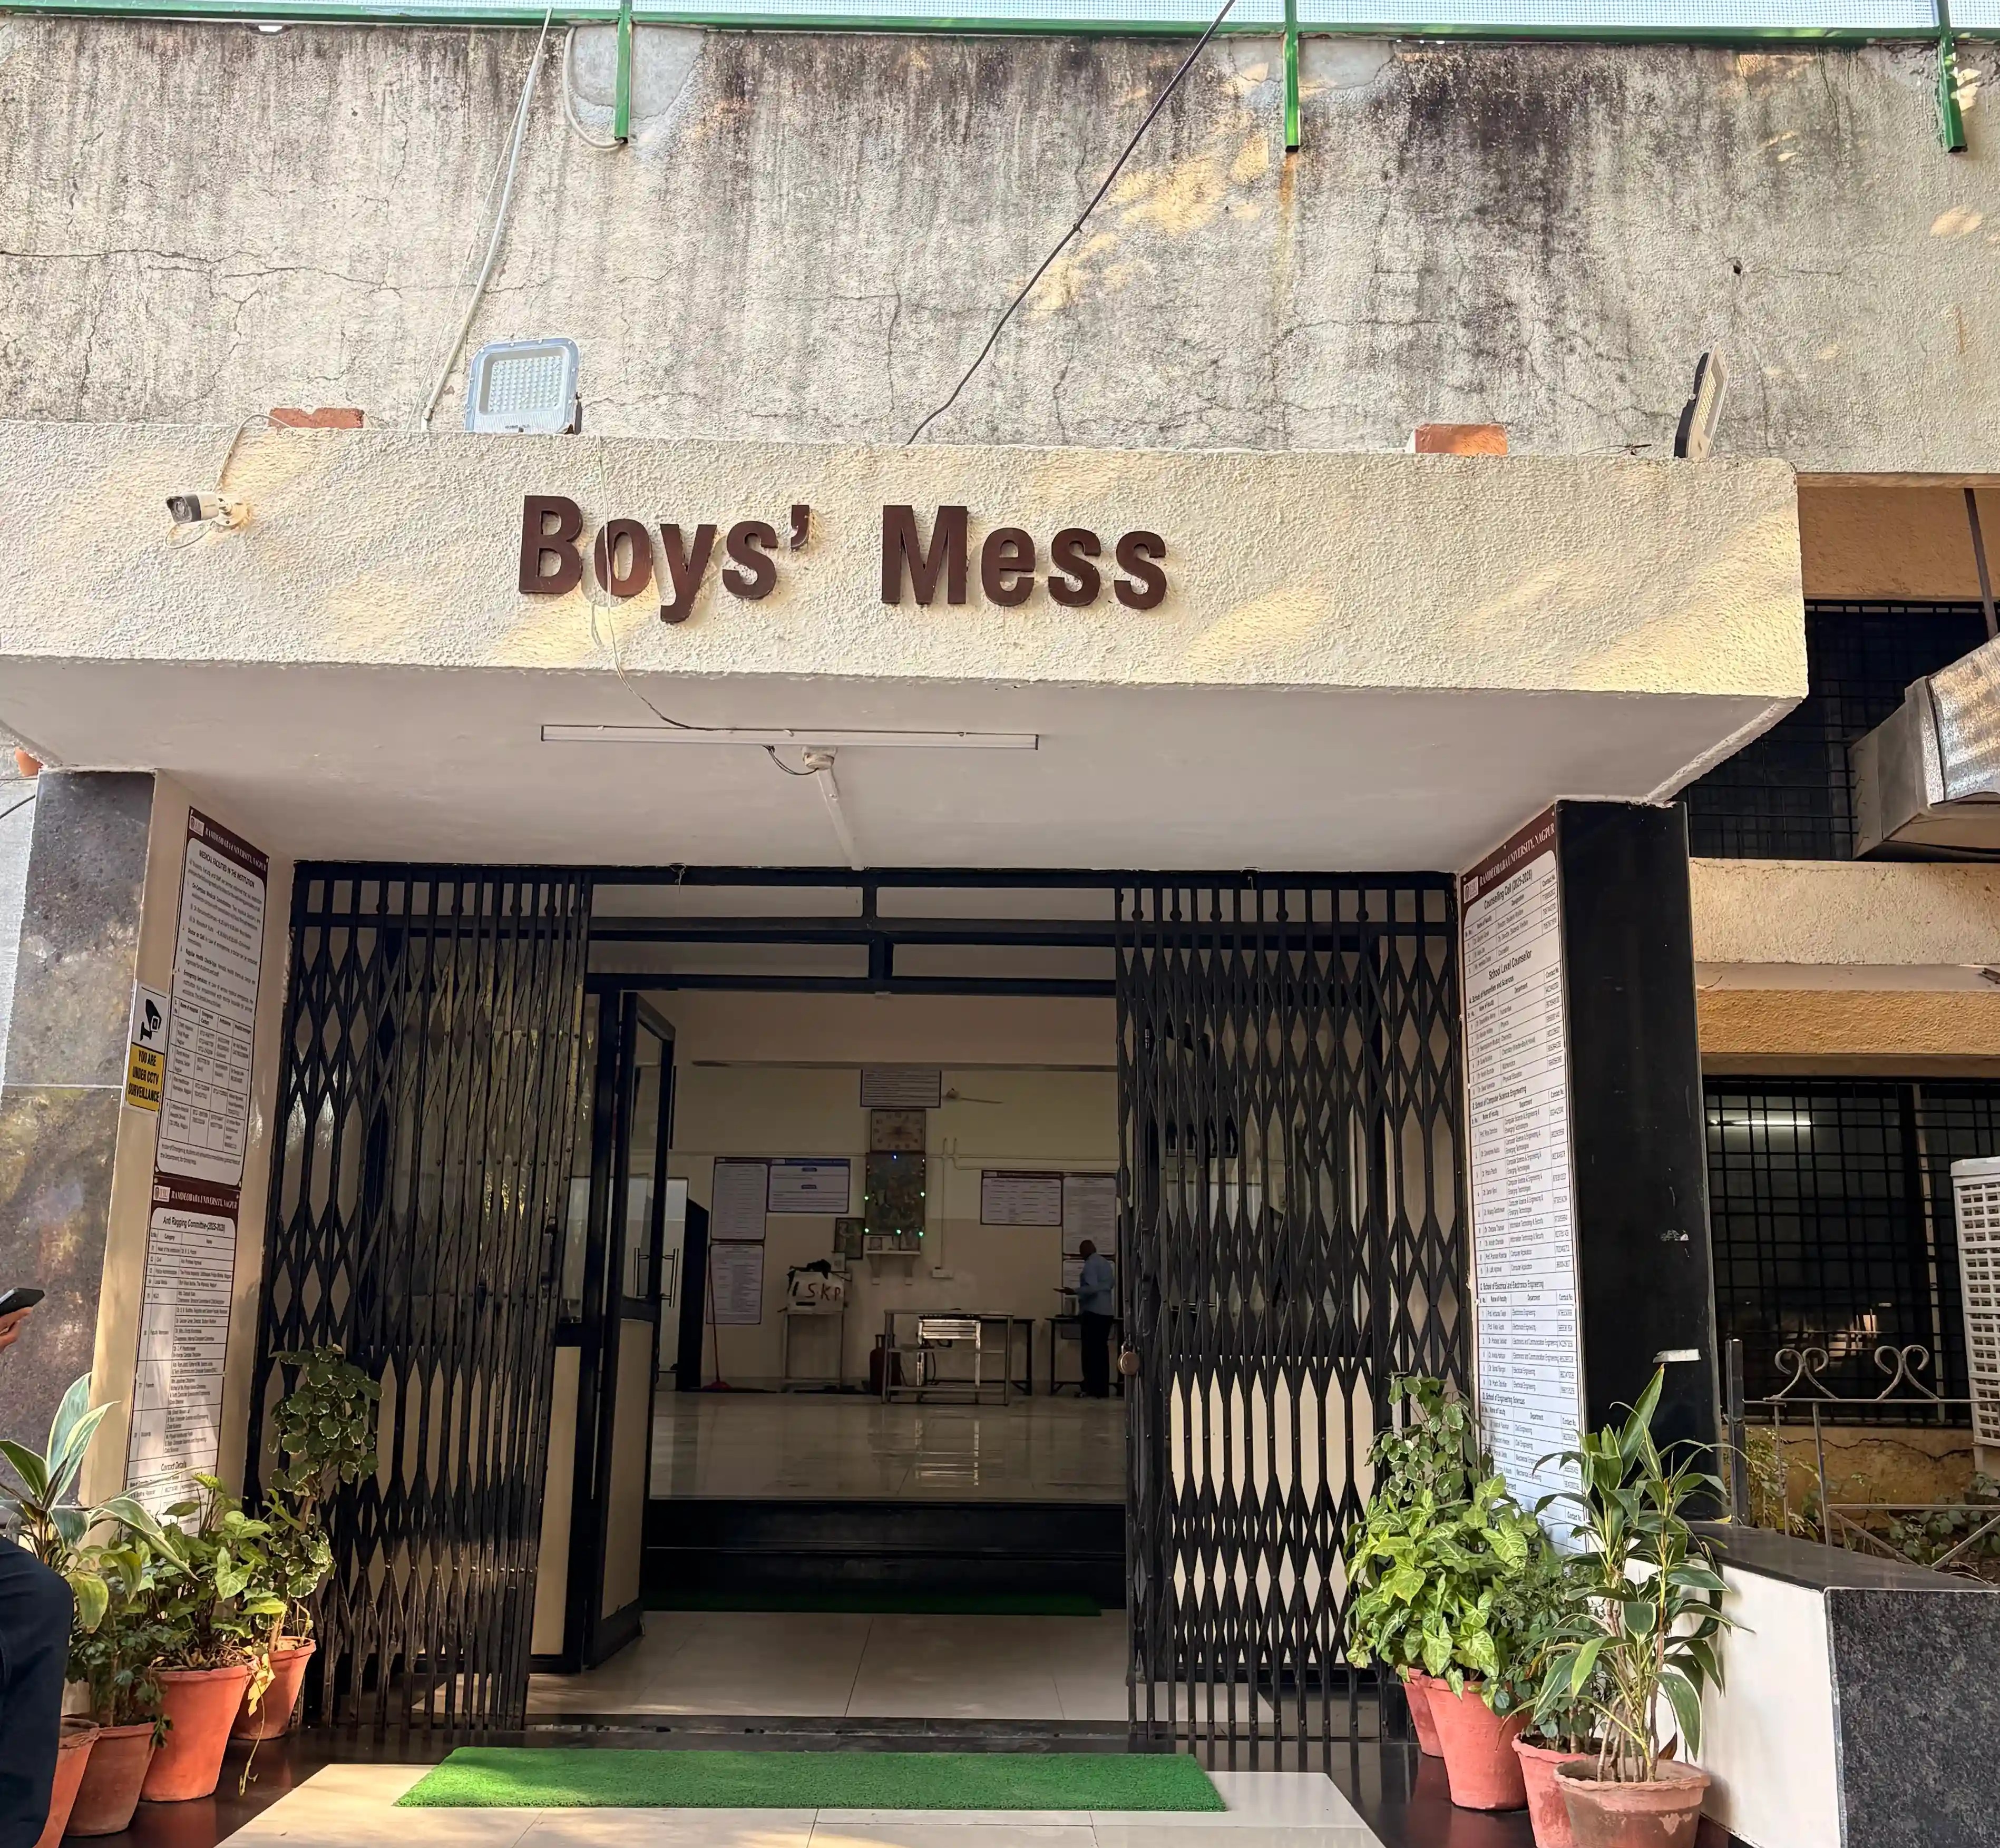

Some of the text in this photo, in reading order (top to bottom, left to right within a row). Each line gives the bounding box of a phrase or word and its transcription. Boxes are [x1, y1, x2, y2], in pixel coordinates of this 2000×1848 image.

[881, 505, 1167, 610] Mess
[1536, 822, 1554, 846] NAGPUR
[1484, 888, 1504, 912] Counselling
[1489, 965, 1500, 981] School
[1501, 959, 1511, 974] Level
[138, 1050, 157, 1067] YOU ARE
[132, 1066, 148, 1081] UNDER
[128, 1082, 160, 1102] SURVEILLANCE
